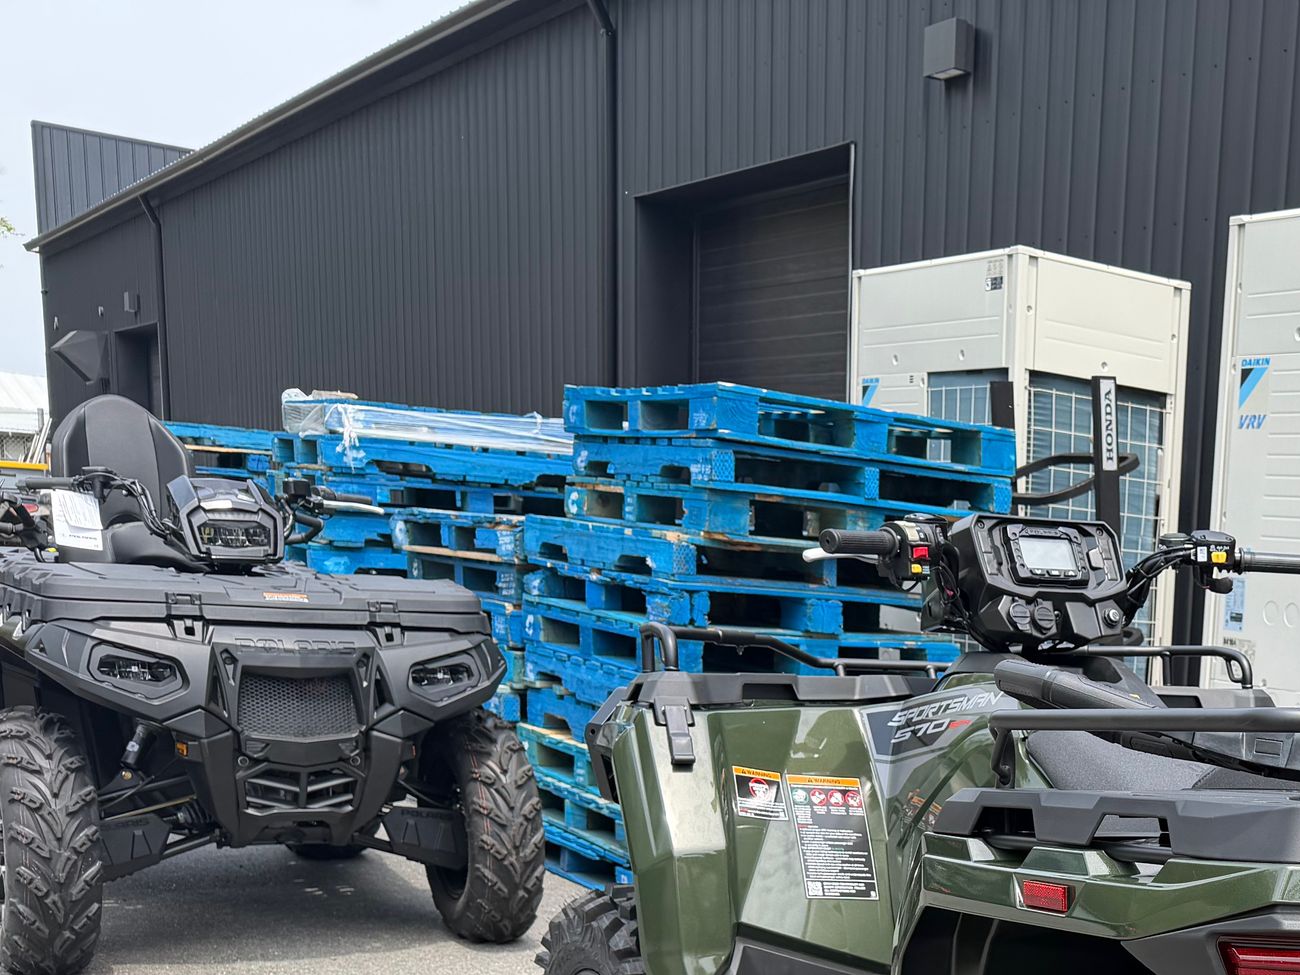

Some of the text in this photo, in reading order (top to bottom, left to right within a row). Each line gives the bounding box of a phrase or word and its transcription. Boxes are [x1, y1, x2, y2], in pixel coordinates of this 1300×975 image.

[1241, 357, 1271, 367] DAIKIN
[1104, 388, 1114, 462] HONDA
[1238, 414, 1266, 430] VRV
[887, 691, 1004, 727] SPORTSMAN
[890, 718, 951, 743] 570
